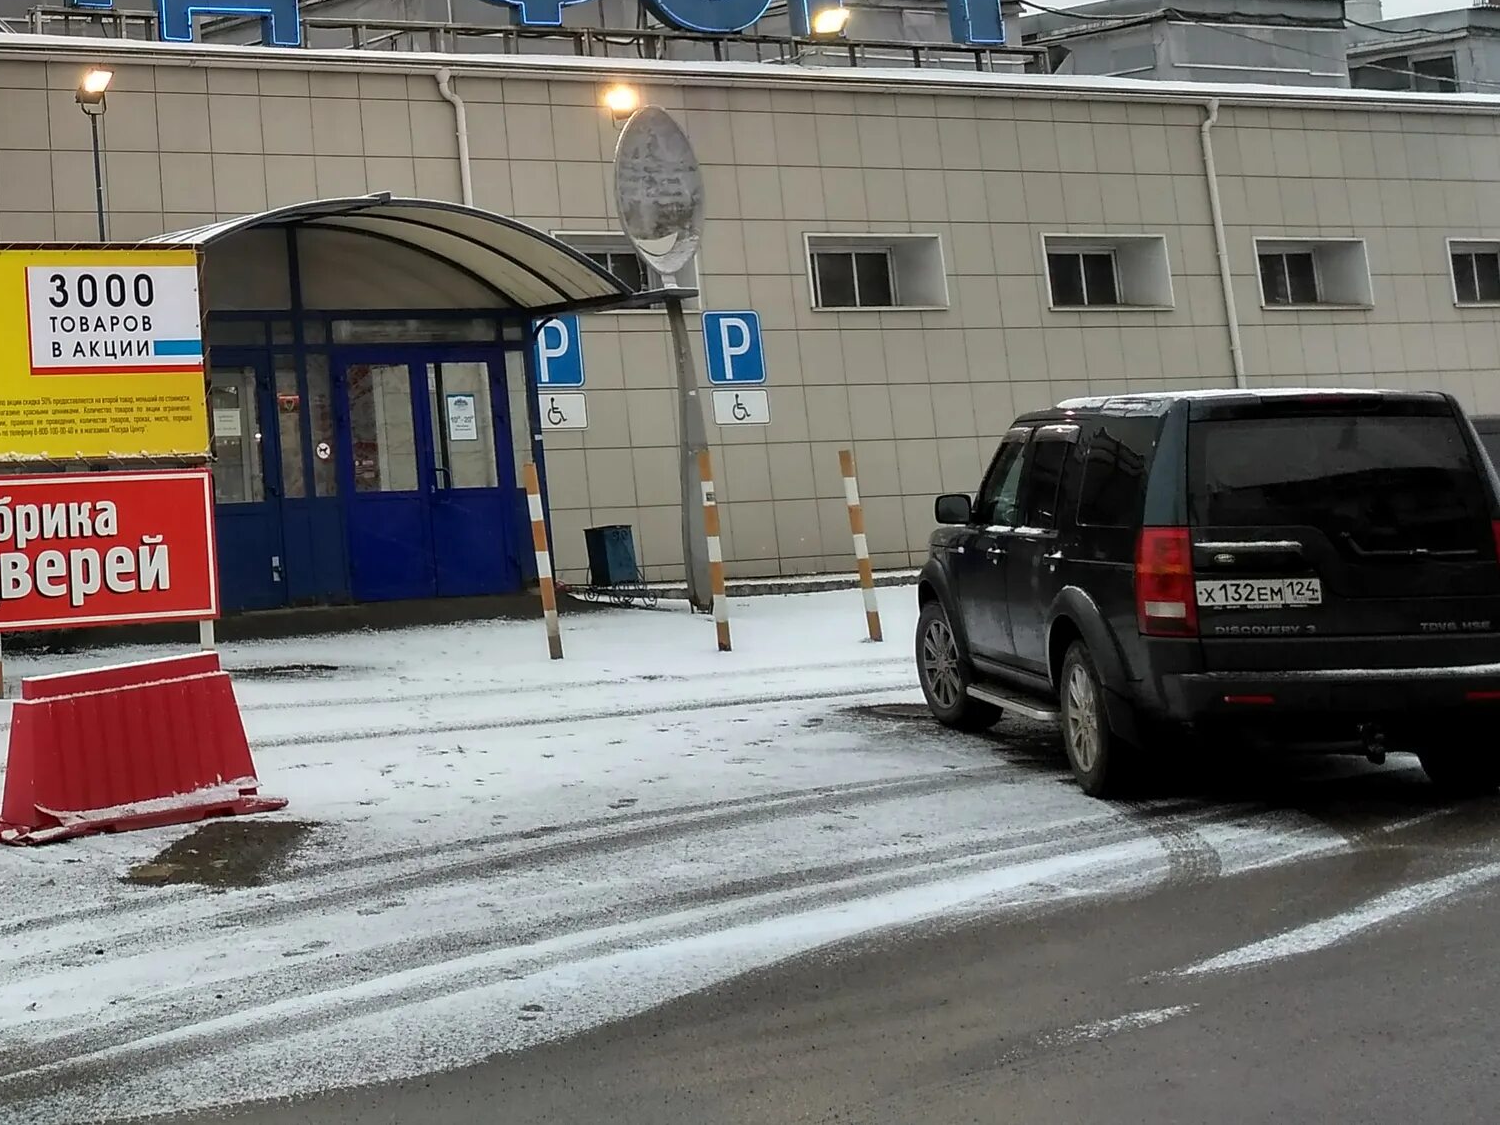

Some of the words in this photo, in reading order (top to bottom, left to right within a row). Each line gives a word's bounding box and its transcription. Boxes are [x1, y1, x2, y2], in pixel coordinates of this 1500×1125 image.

[49, 274, 154, 308] 3000
[49, 316, 152, 333] ТОВАРОВ
[52, 342, 62, 357] В
[73, 340, 150, 359] АКЦИИ
[719, 317, 751, 380] P
[1286, 581, 1316, 596] 124
[1215, 625, 1300, 635] DISCOVERY
[1305, 624, 1317, 634] 3
